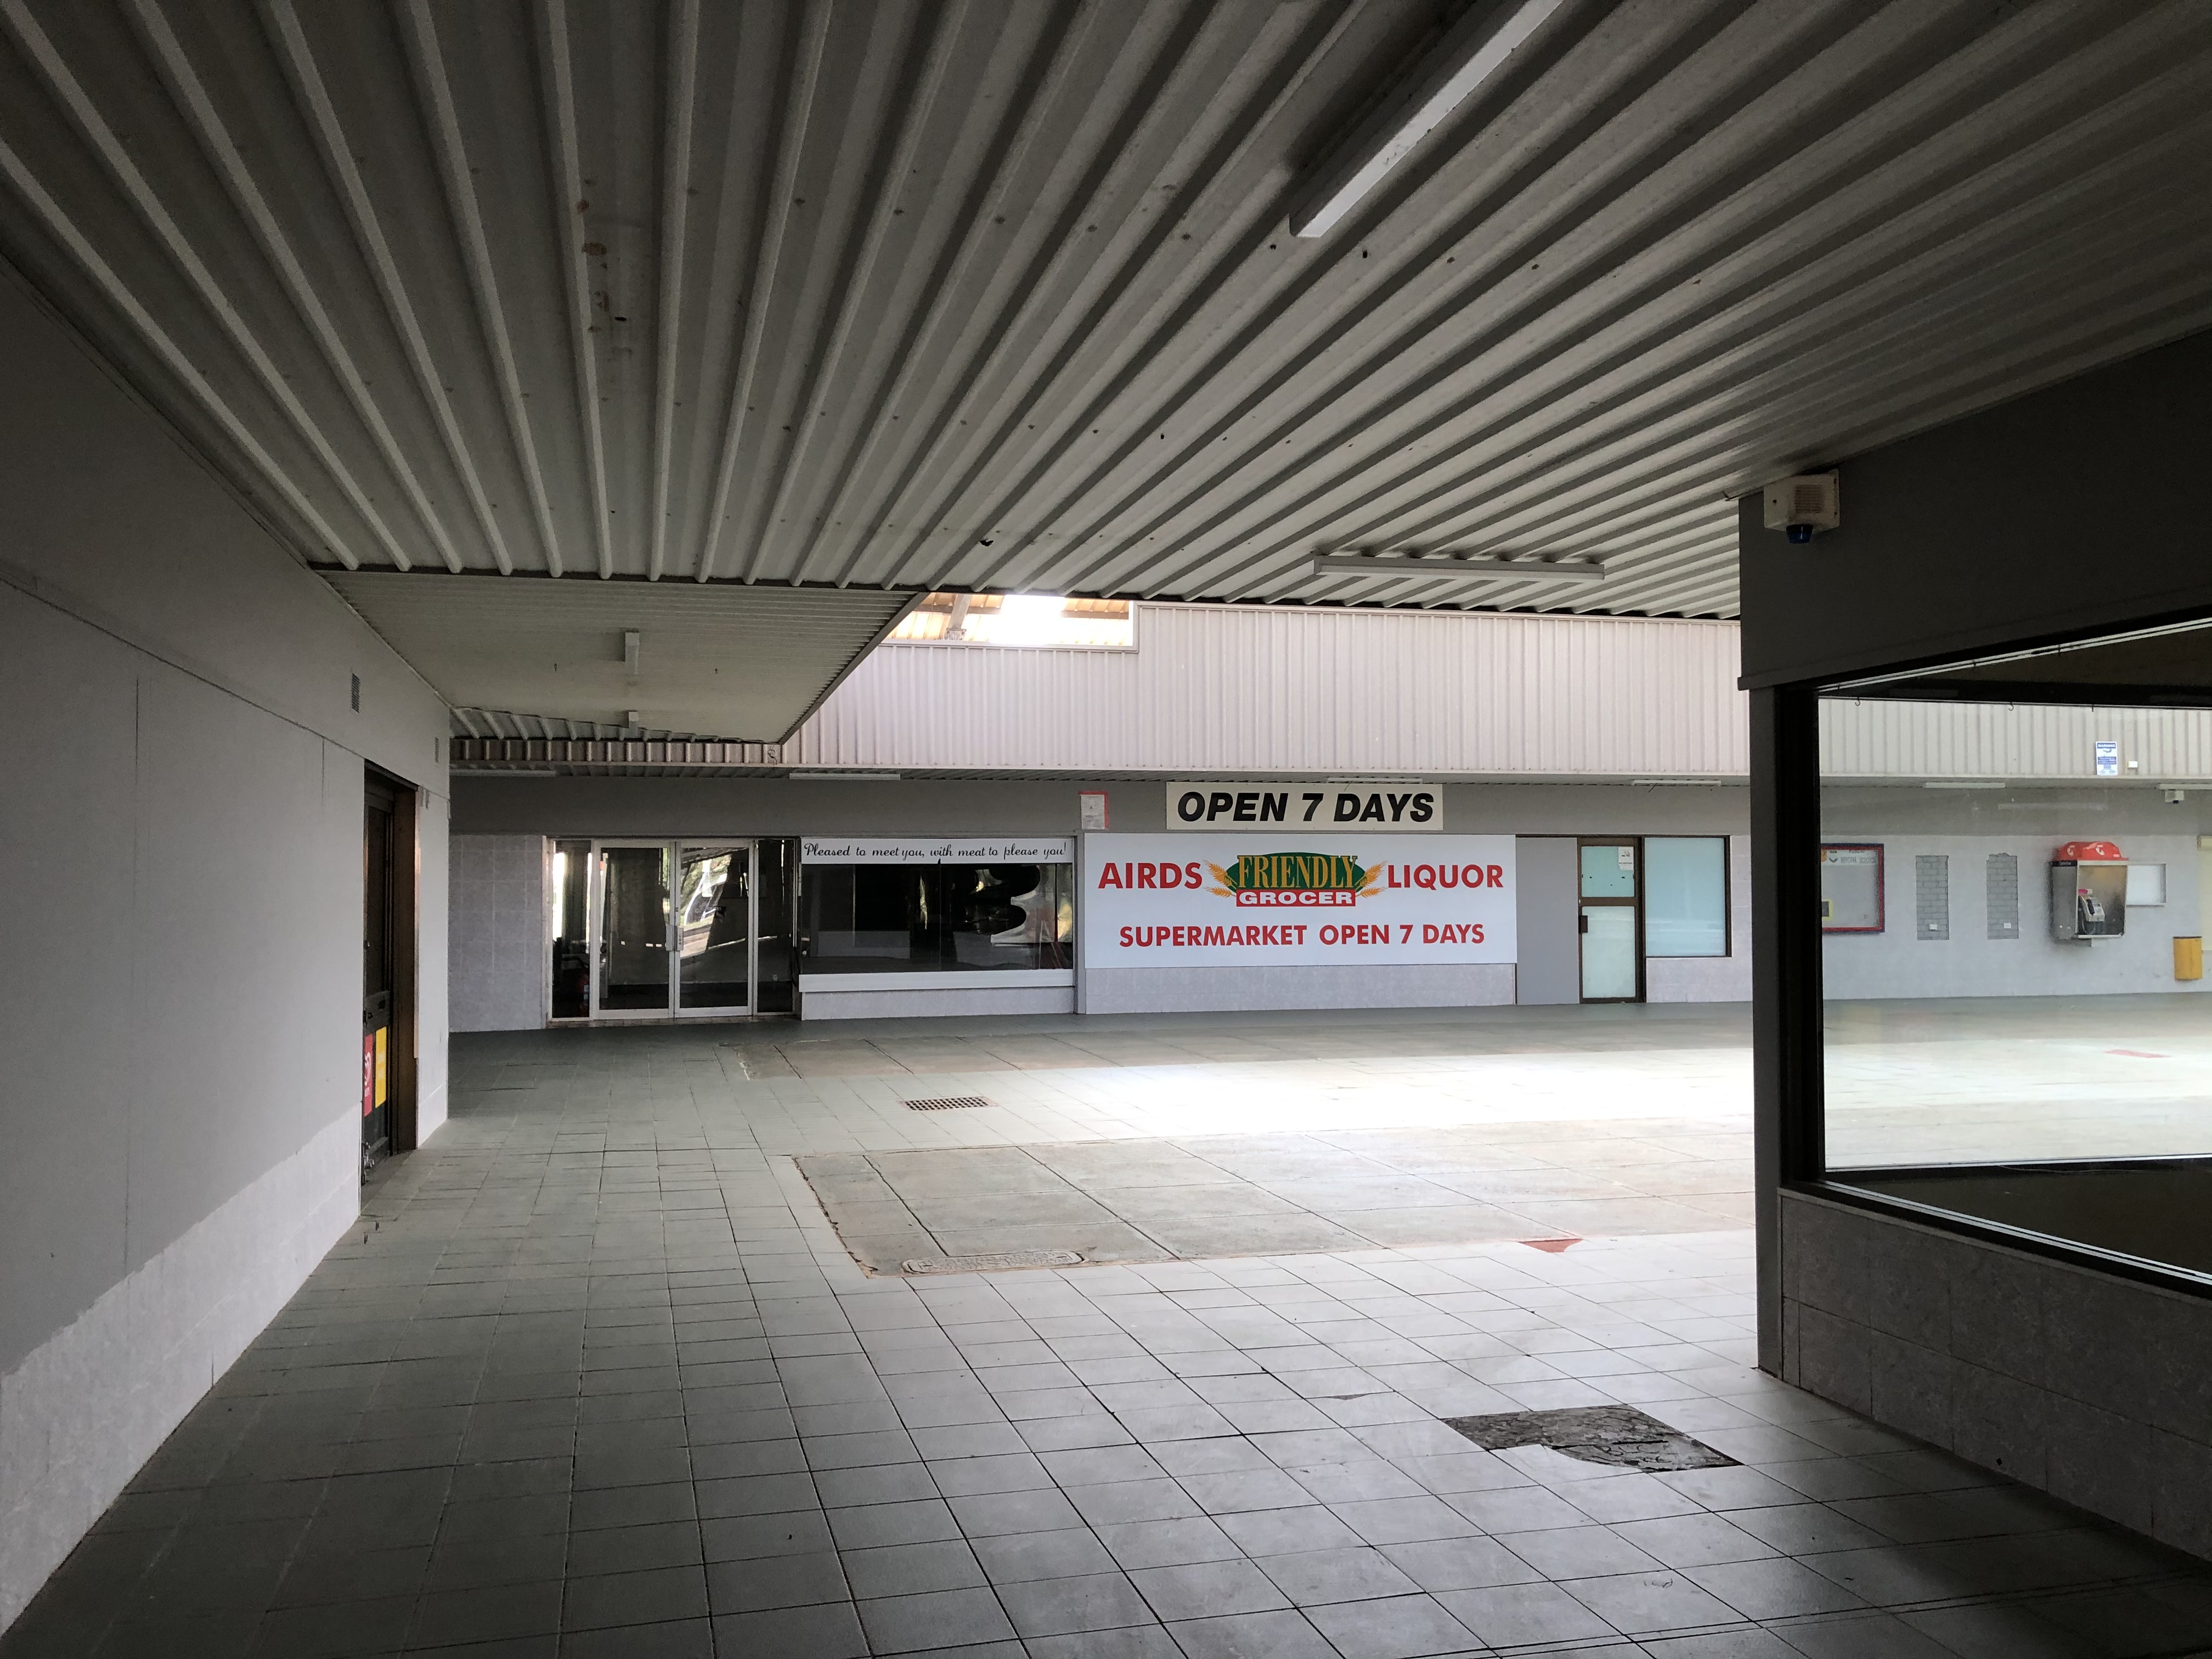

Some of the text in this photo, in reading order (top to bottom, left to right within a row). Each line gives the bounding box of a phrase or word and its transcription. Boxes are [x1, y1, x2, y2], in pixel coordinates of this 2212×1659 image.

[1177, 791, 1435, 822] OPEN 7 DAYS
[804, 842, 1066, 861] Pleased to meet you, with meat to please you!
[1098, 862, 1202, 889] AIRDS
[1237, 855, 1358, 888] FRIENDLY
[1388, 865, 1503, 890] LIQUOR
[1238, 891, 1352, 905] GROCER
[1120, 924, 1485, 947] SUPERMARKET OPEN 7 DAYS
